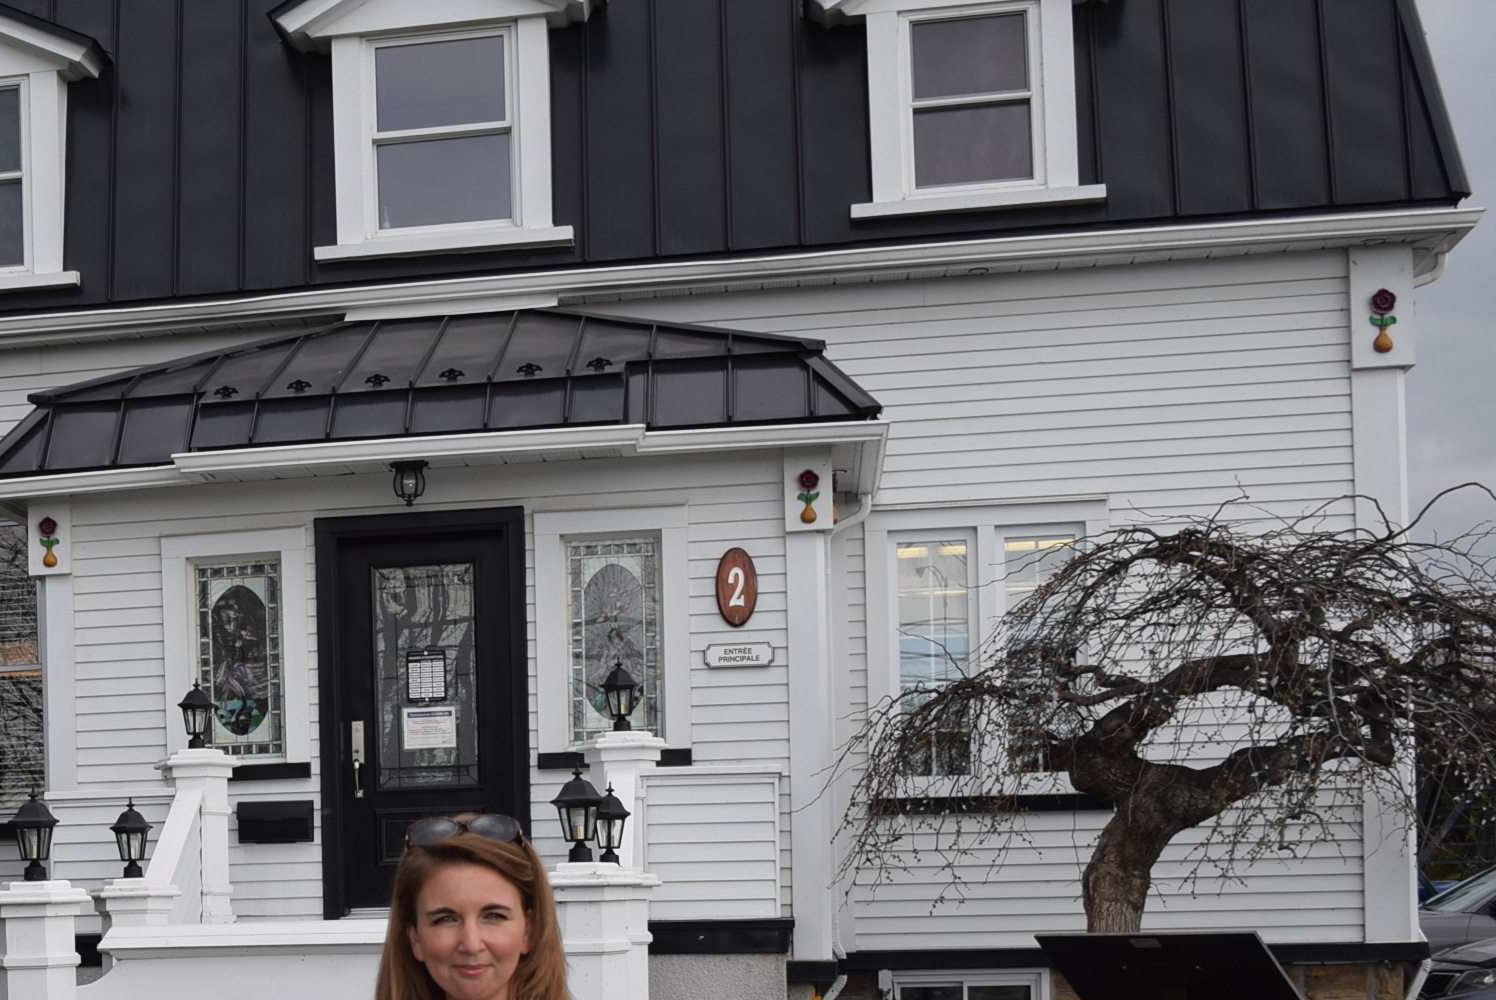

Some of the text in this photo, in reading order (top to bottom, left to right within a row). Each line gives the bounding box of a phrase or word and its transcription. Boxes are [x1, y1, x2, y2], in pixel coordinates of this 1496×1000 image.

[727, 566, 745, 608] 2
[723, 647, 753, 656] ENTRÉE
[718, 655, 760, 663] PRINCIPALE
